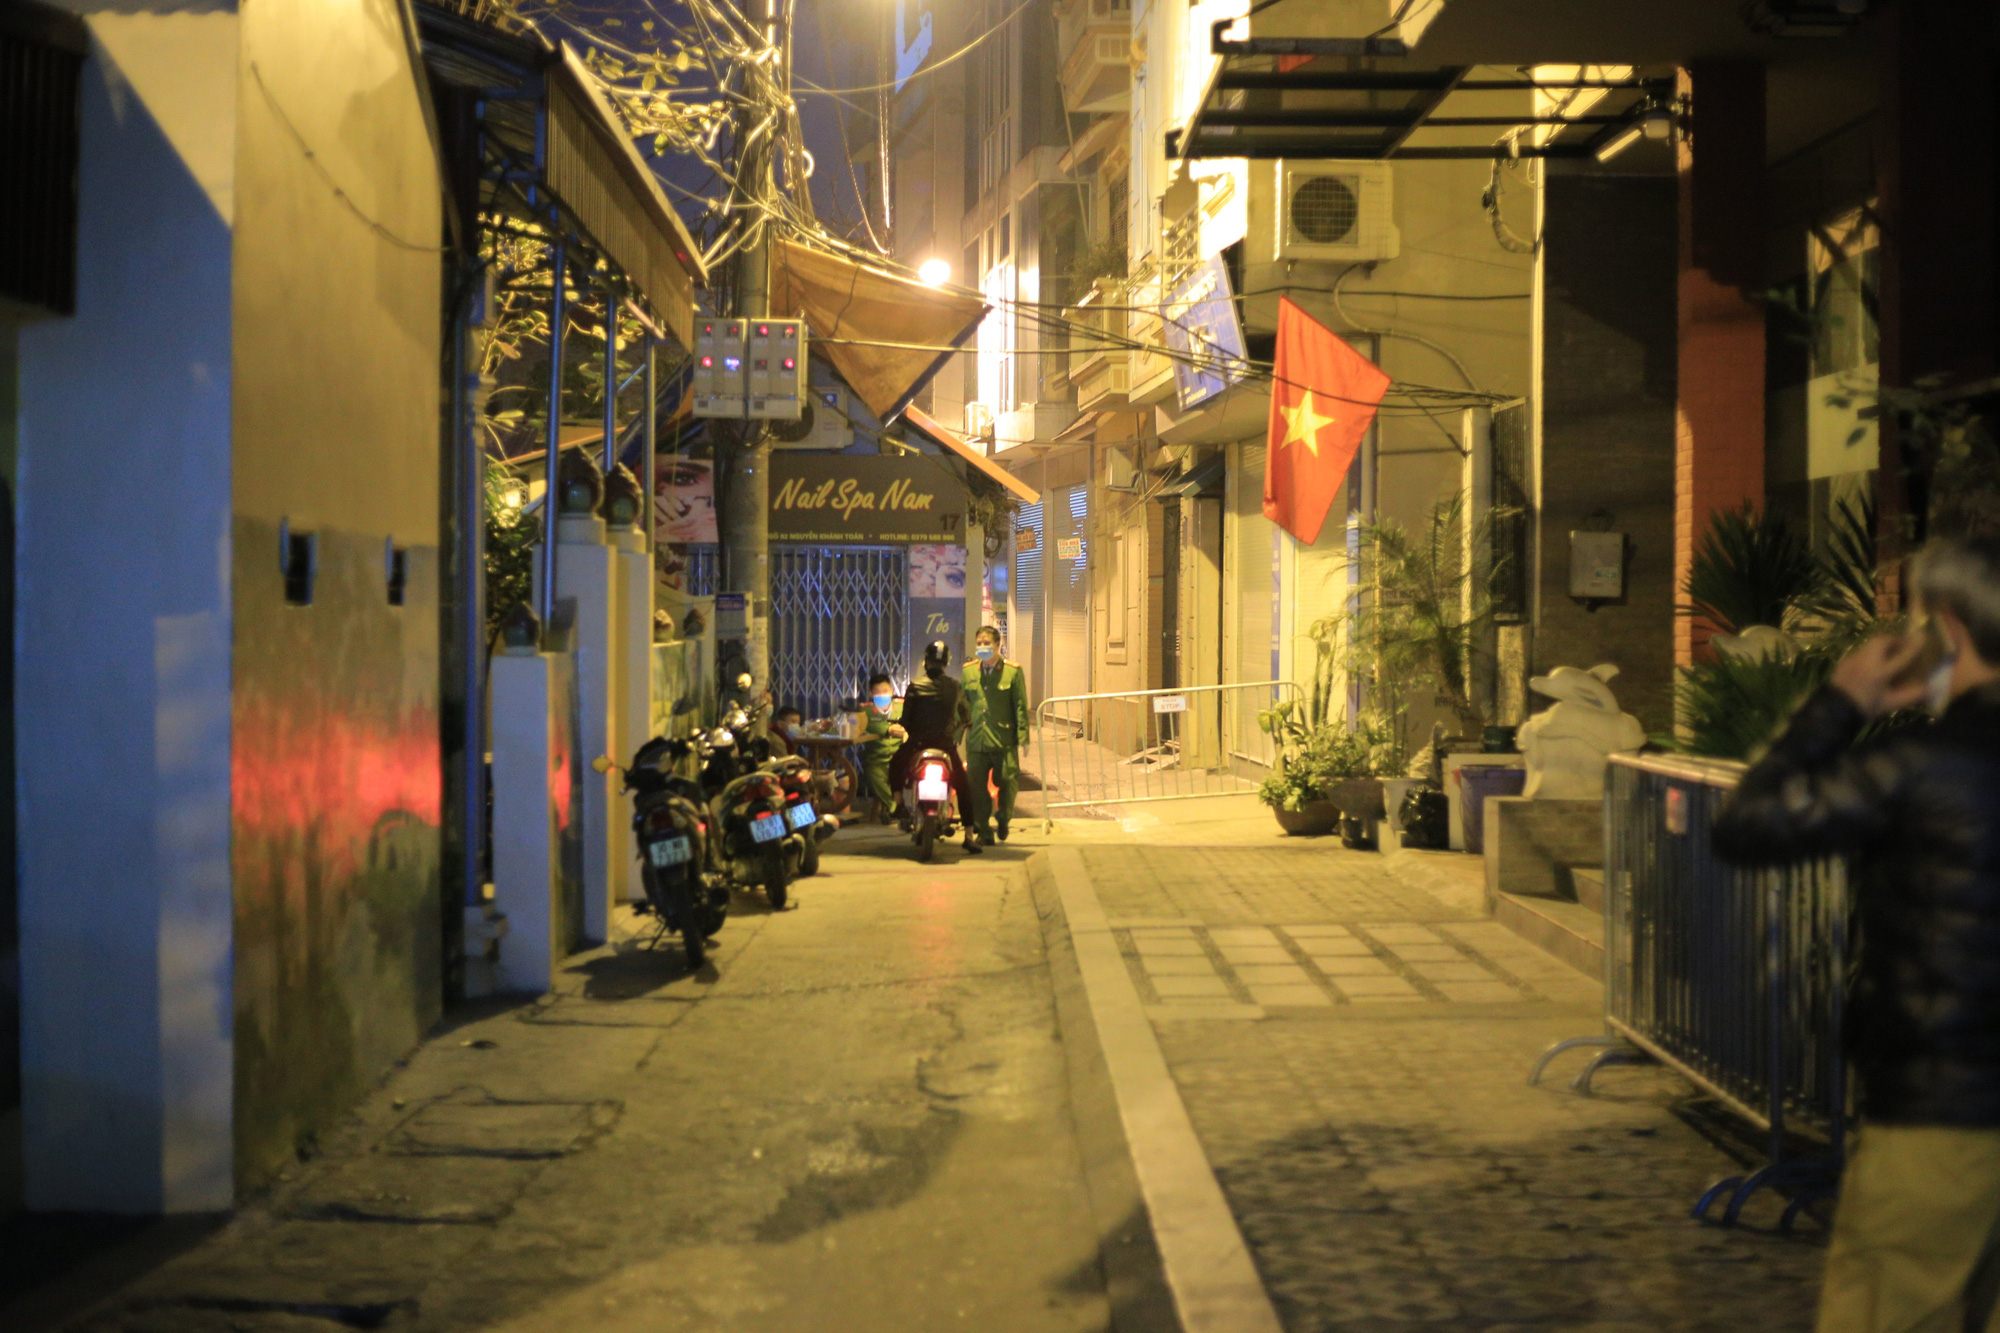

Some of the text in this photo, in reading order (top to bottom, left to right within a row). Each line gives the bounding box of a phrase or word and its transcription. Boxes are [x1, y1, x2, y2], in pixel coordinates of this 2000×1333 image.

[774, 478, 935, 521] Nail Spa Nam
[940, 513, 961, 531] 17
[880, 533, 910, 541] HOTLINE:
[926, 613, 950, 634] Tóc
